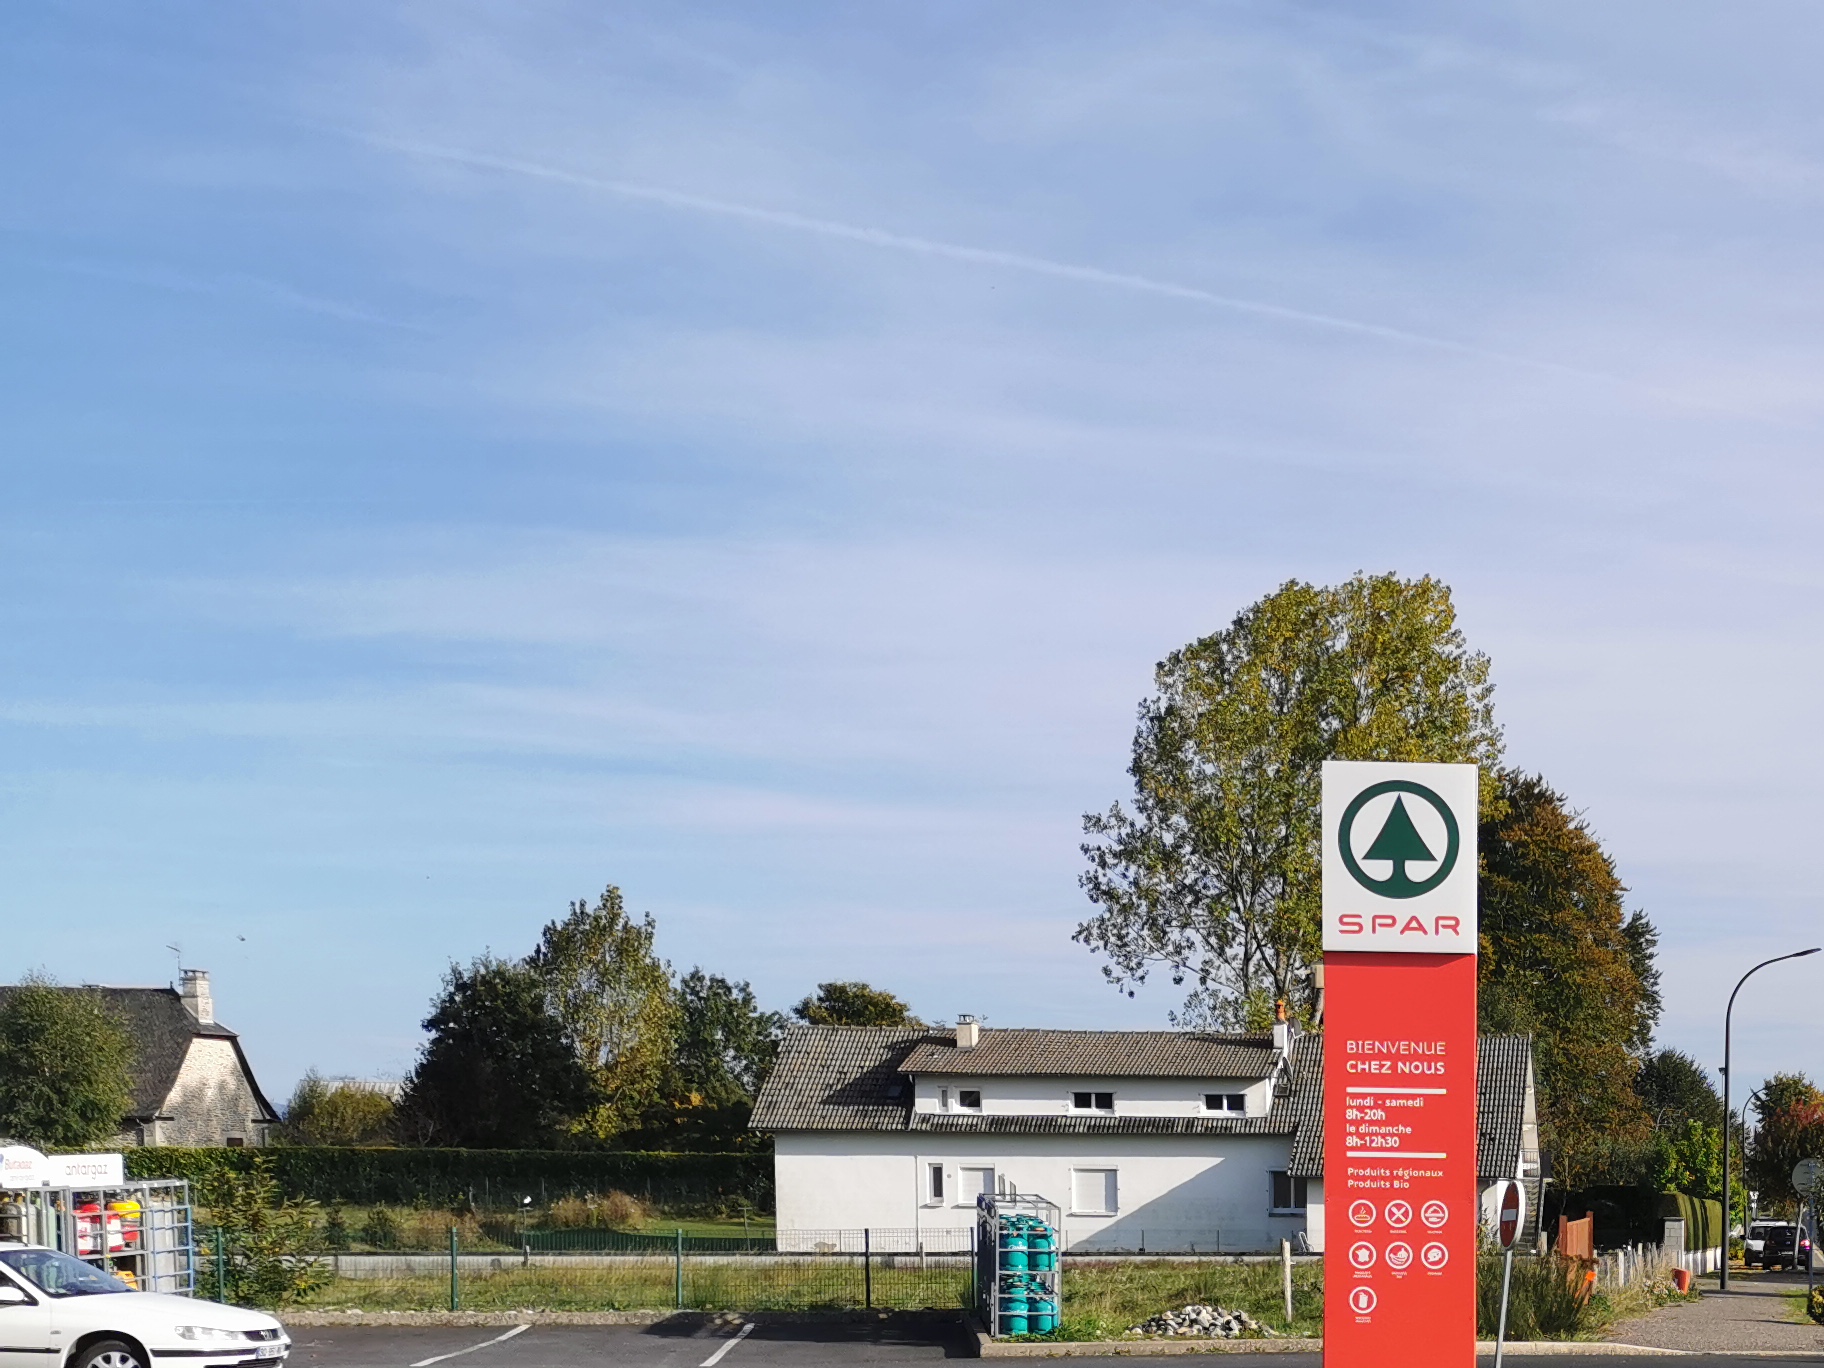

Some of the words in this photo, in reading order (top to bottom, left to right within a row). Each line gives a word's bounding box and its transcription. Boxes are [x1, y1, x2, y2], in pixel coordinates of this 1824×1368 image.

[1338, 914, 1461, 936] SPAR
[1346, 1040, 1446, 1055] BIENVENUE
[1346, 1060, 1392, 1074] CHEZ
[1397, 1061, 1445, 1075] NOUS
[1346, 1096, 1374, 1107] lundi
[1385, 1098, 1424, 1107] samedi
[1345, 1108, 1386, 1120] 8h-20h
[1346, 1124, 1356, 1133] le
[1358, 1124, 1412, 1134] dimanche
[1345, 1137, 1400, 1148] 8h-12h30
[65, 1163, 108, 1180] antargaz
[1347, 1167, 1390, 1177] Produits
[1393, 1167, 1444, 1179] régionaux
[1347, 1178, 1390, 1189] Produits
[1393, 1180, 1410, 1189] Bio
